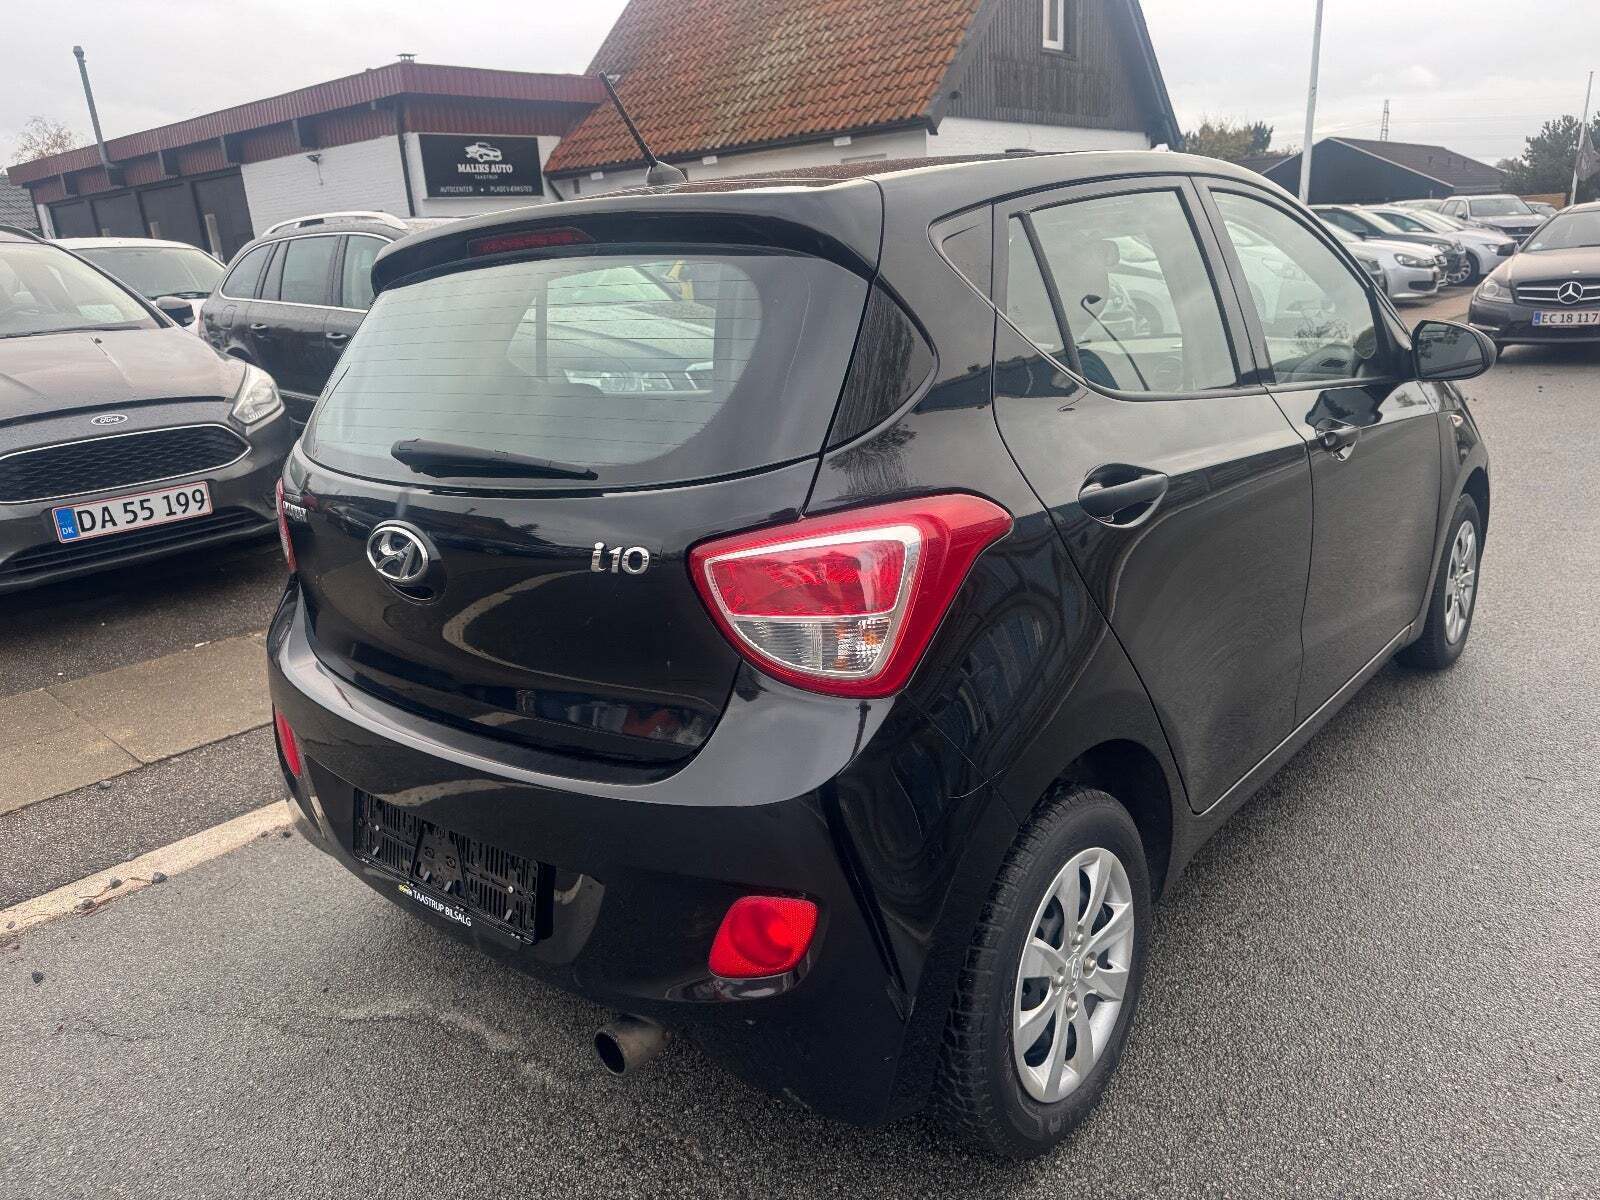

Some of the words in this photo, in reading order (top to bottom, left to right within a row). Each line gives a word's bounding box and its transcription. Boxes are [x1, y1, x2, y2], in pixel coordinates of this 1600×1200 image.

[457, 164, 491, 173] MALIKS
[491, 164, 513, 173] AUTO
[1542, 313, 1557, 323] EC
[1560, 313, 1573, 323] 18
[1577, 312, 1599, 323] 117
[76, 506, 118, 533] DA
[122, 498, 154, 524] 55
[161, 488, 206, 517] 199
[61, 526, 74, 535] DK
[591, 541, 650, 575] i10
[412, 889, 445, 912] TAASTRUP
[444, 906, 472, 927] BILSALG
